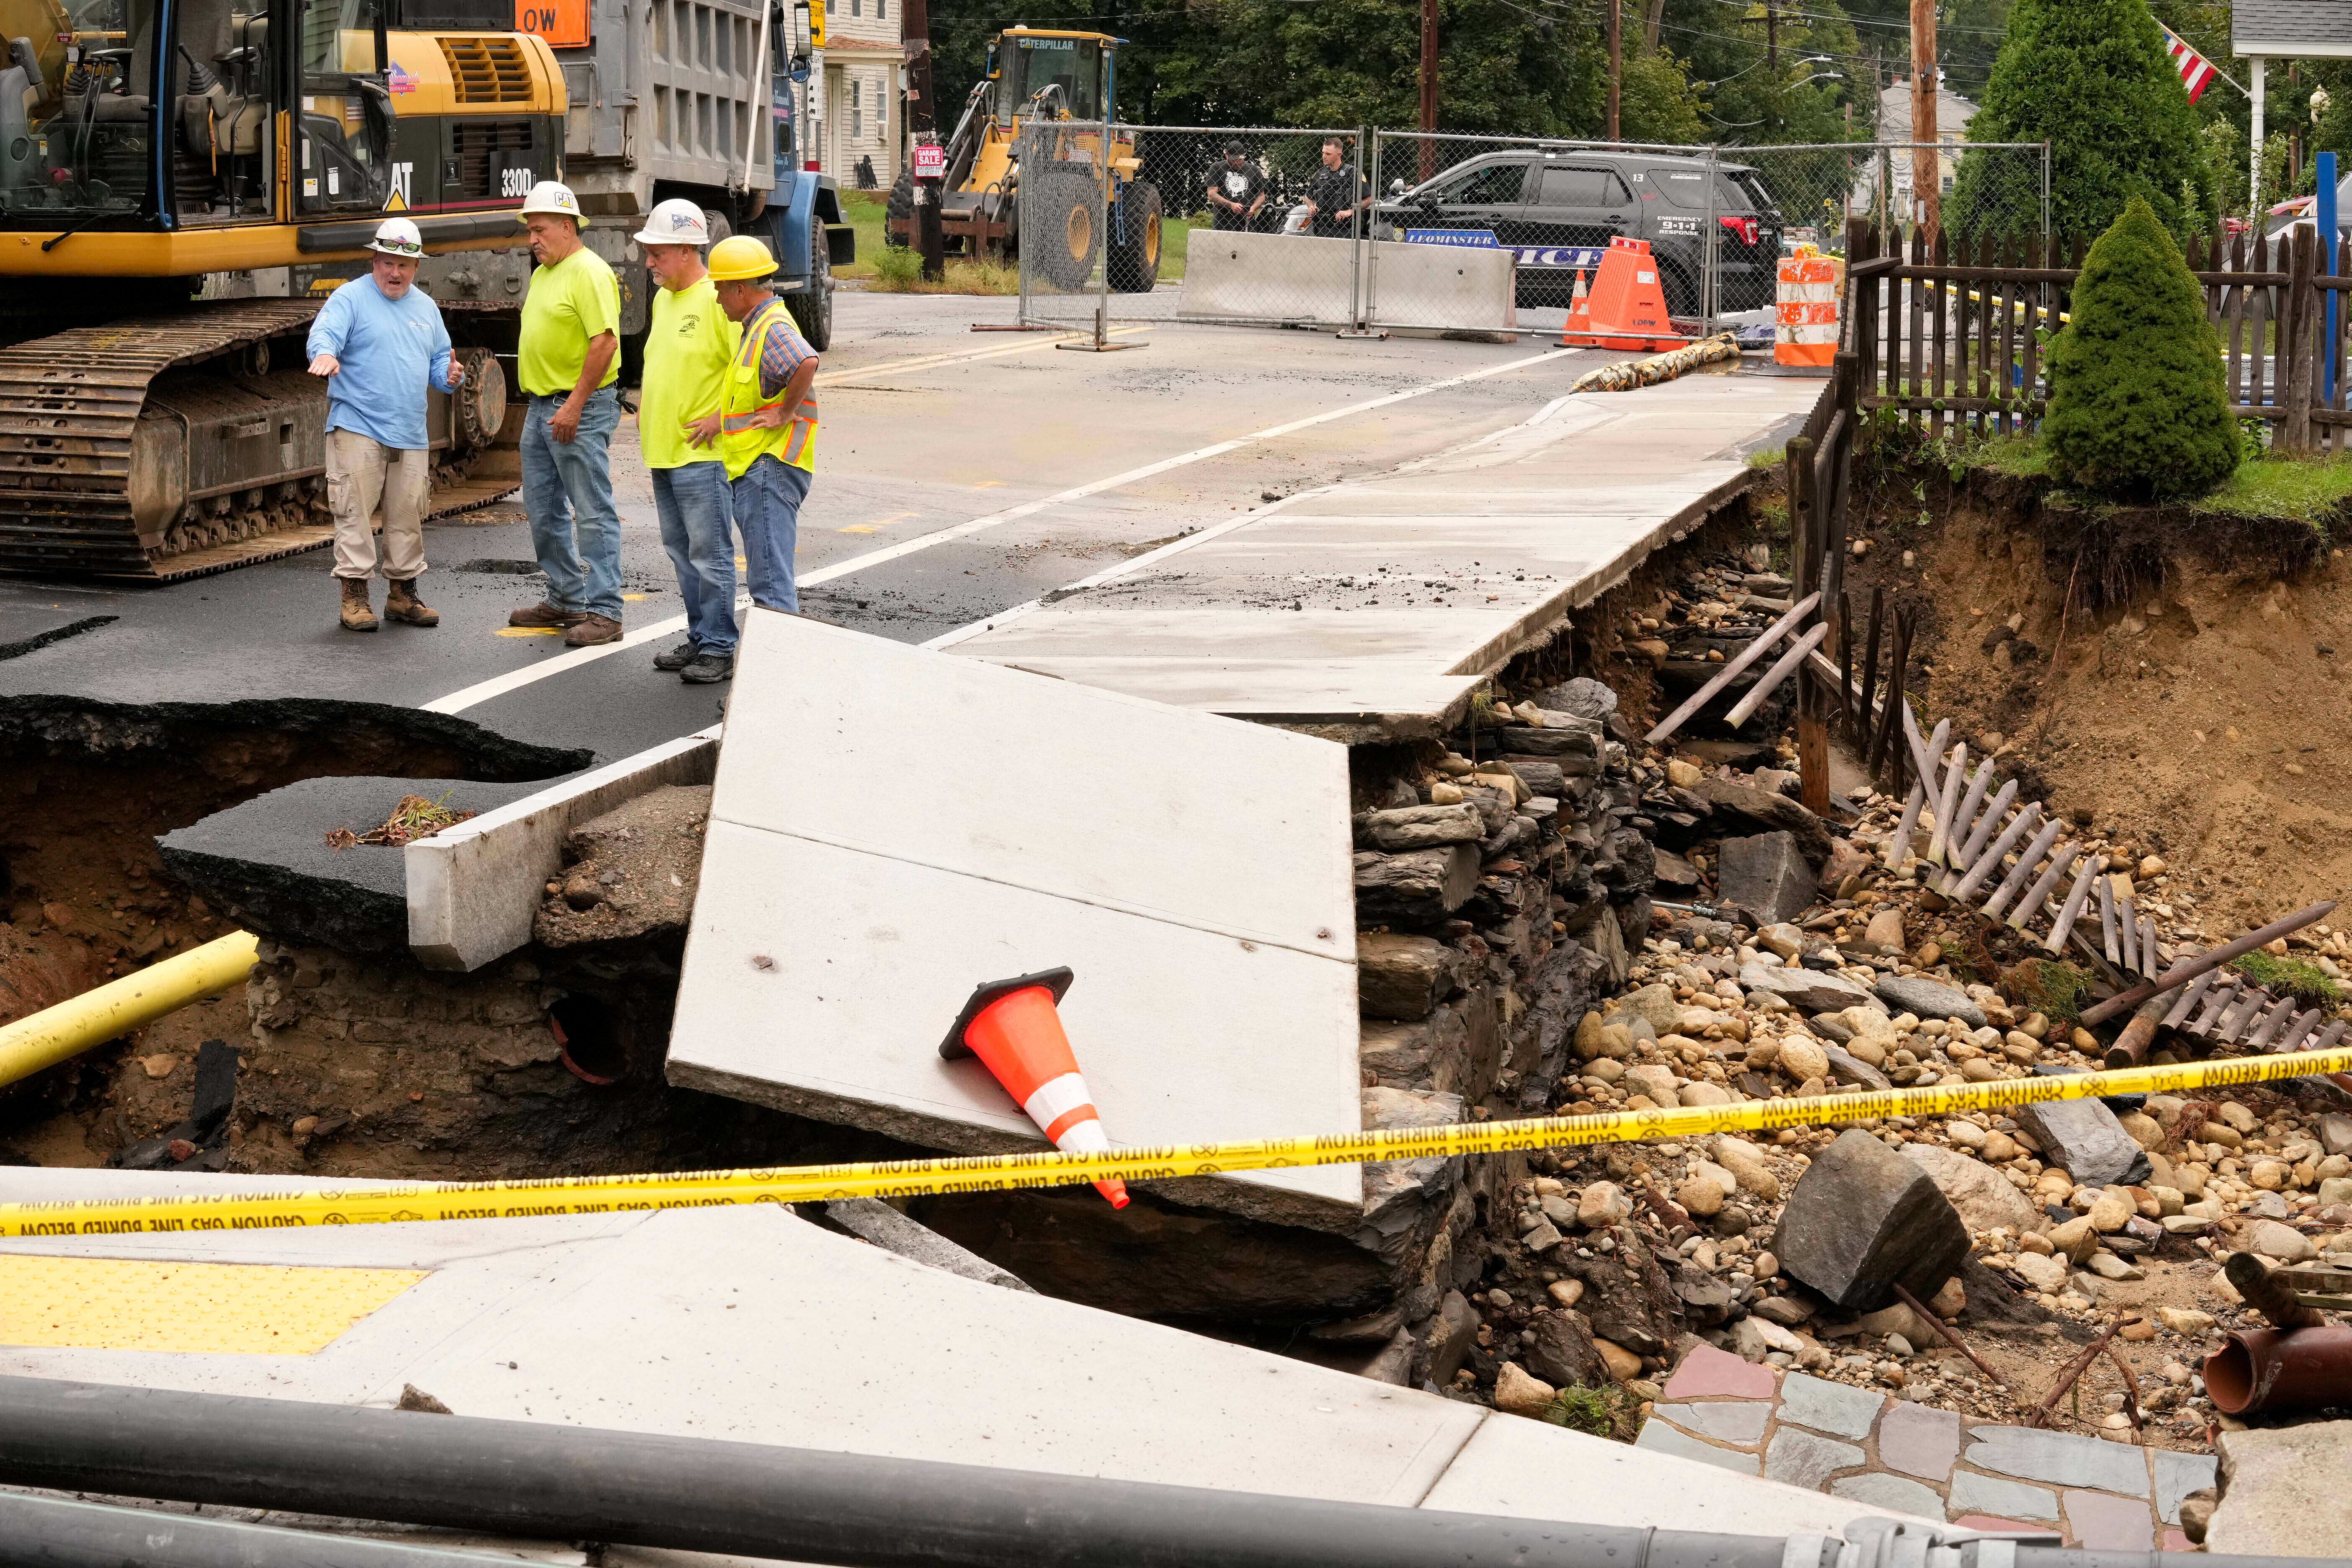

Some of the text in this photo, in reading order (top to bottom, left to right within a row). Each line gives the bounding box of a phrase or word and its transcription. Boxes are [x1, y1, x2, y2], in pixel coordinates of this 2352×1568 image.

[519, 9, 556, 32] OW
[1020, 38, 1073, 50] CATERPILLAR
[918, 156, 940, 165] SALE
[555, 192, 573, 208] CAT
[1409, 235, 1493, 244] LEOMINSTER
[1519, 250, 1606, 265] ICE
